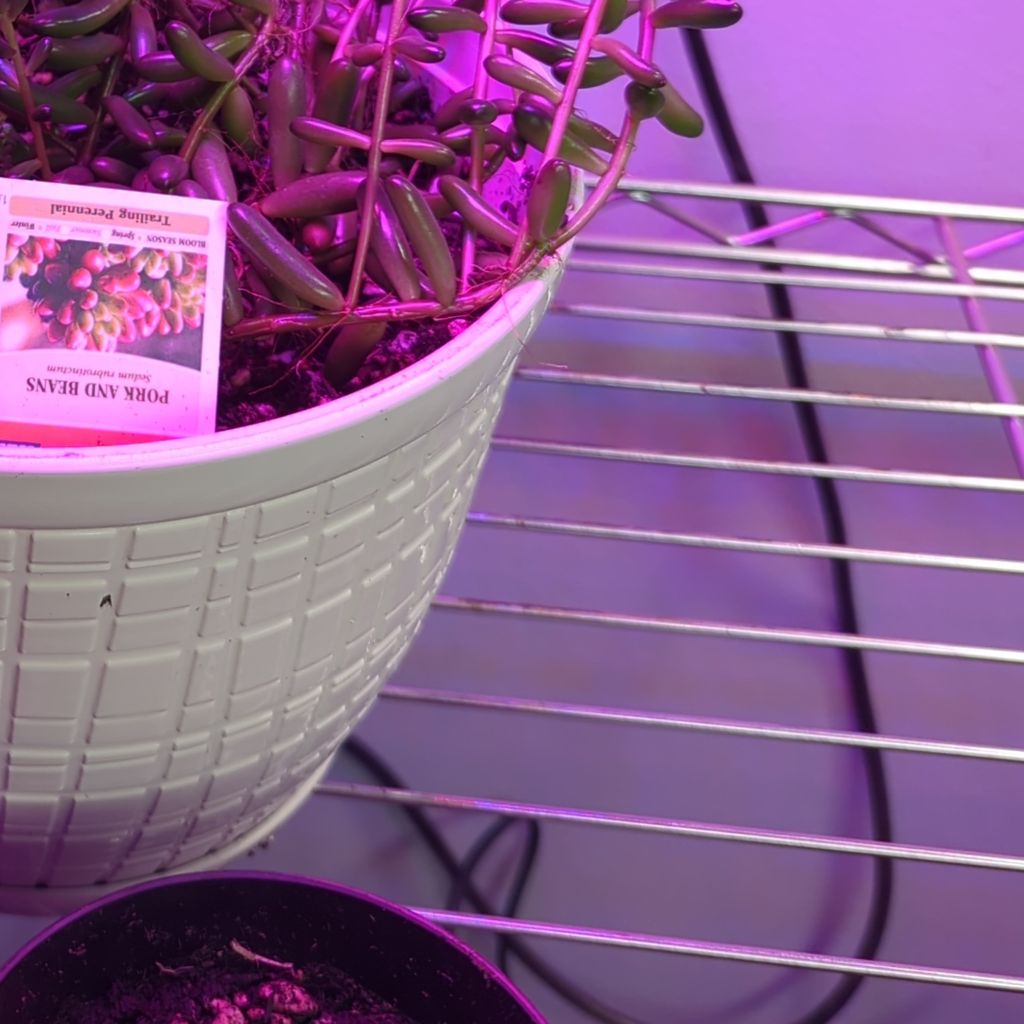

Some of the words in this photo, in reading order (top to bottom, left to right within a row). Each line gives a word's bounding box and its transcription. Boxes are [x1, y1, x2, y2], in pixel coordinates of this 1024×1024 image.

[50, 203, 114, 221] Perennial
[118, 208, 171, 227] Trailing
[10, 220, 36, 231] Winter
[111, 229, 136, 241] Spring
[146, 234, 177, 246] SEASON
[178, 236, 207, 248] BLOOM
[46, 365, 115, 382] rubrotinctum
[118, 371, 152, 384] Sedum
[26, 377, 79, 396] BEANS
[84, 381, 119, 400] AND
[124, 386, 170, 405] PORK
